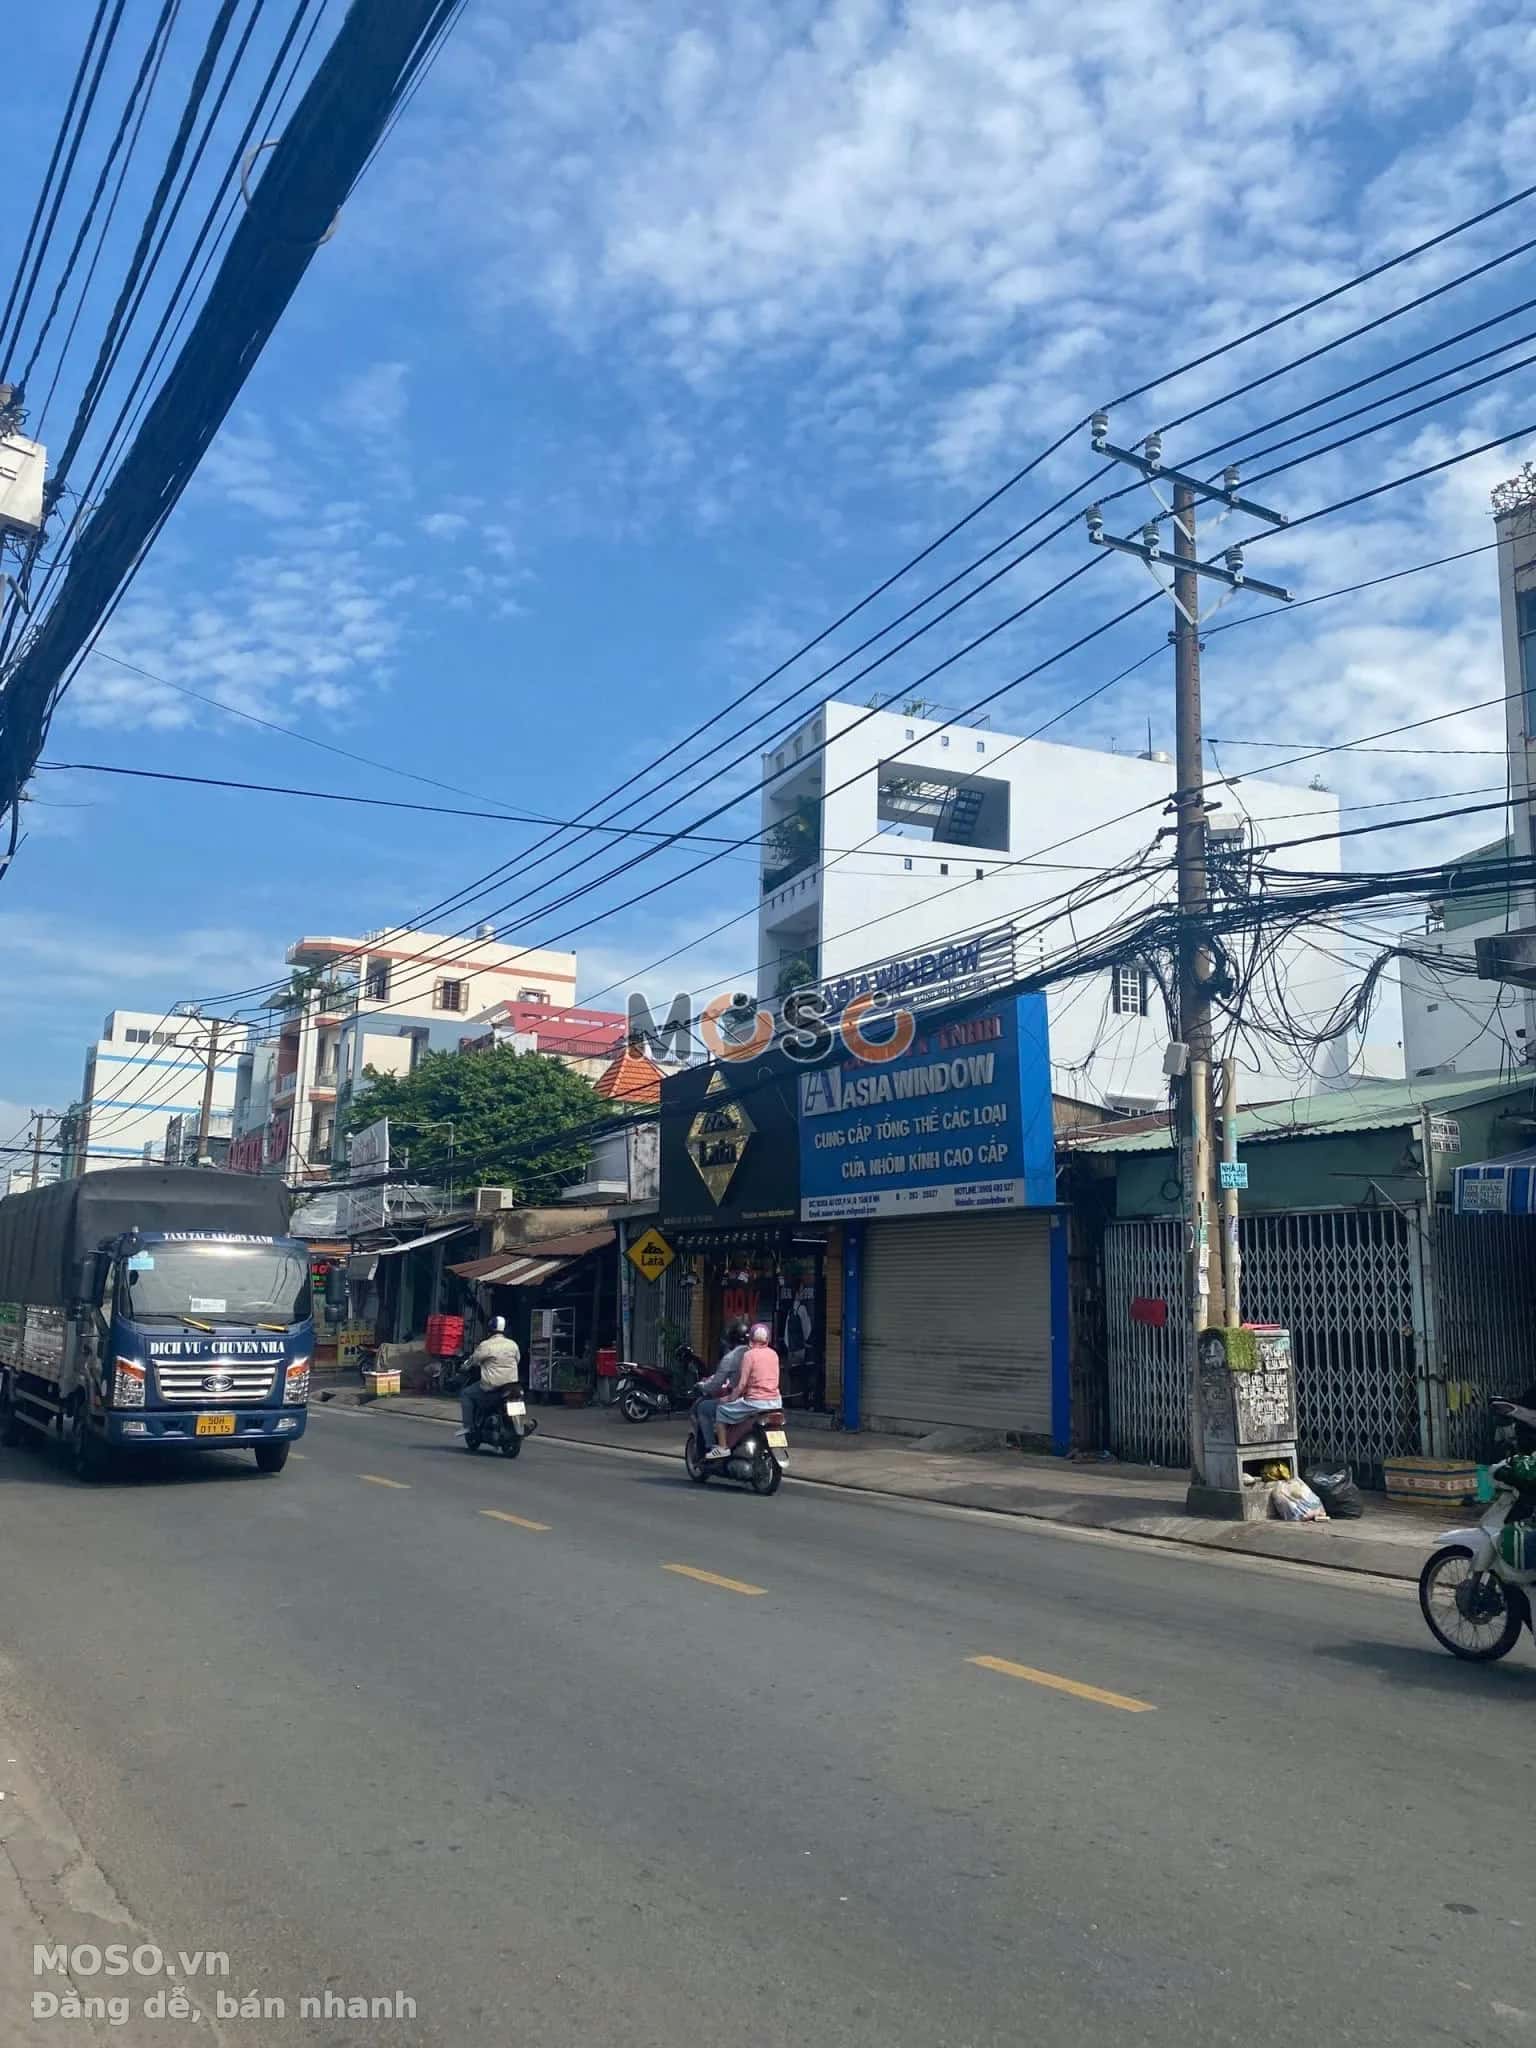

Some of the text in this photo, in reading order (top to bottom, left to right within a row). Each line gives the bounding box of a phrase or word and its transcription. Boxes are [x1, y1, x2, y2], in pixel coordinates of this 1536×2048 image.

[814, 1132, 846, 1150] CUNG
[847, 1118, 873, 1145] CẤP
[943, 1106, 971, 1130] CÁC
[974, 1103, 1007, 1127] LOẠI
[909, 1146, 940, 1172] KÍNH
[943, 1148, 974, 1168] CAO
[978, 1134, 1009, 1164] CẤP
[211, 1341, 260, 1354] CHUYEN
[260, 1341, 285, 1353] NHA
